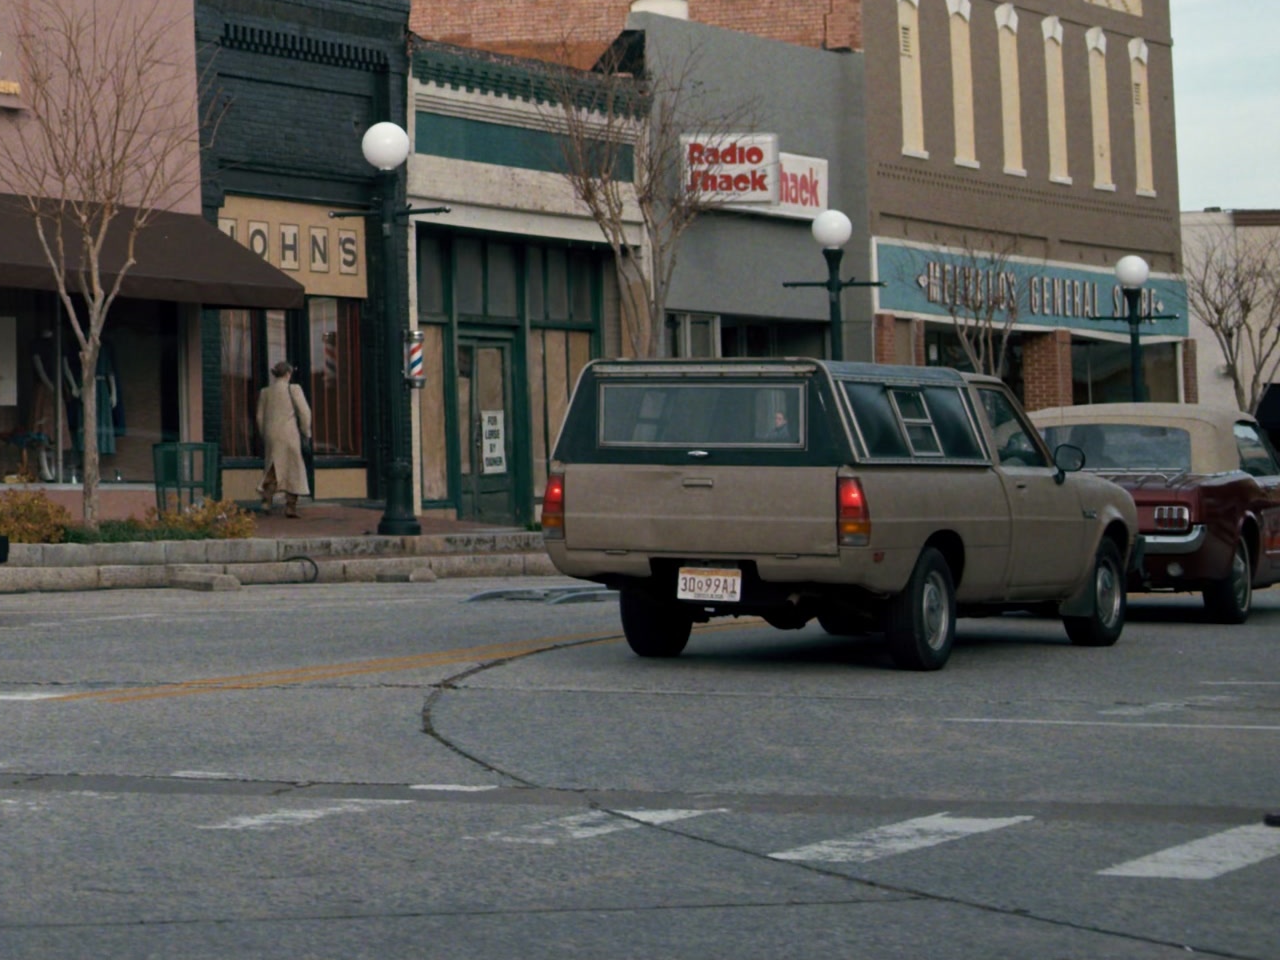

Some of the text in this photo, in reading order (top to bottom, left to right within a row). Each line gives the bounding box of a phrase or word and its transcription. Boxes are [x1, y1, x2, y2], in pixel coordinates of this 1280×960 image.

[689, 142, 764, 165] Radio
[686, 169, 769, 192] Shack
[779, 161, 820, 208] hack
[1029, 276, 1101, 319] GENERAL
[1111, 284, 1157, 324] STRE
